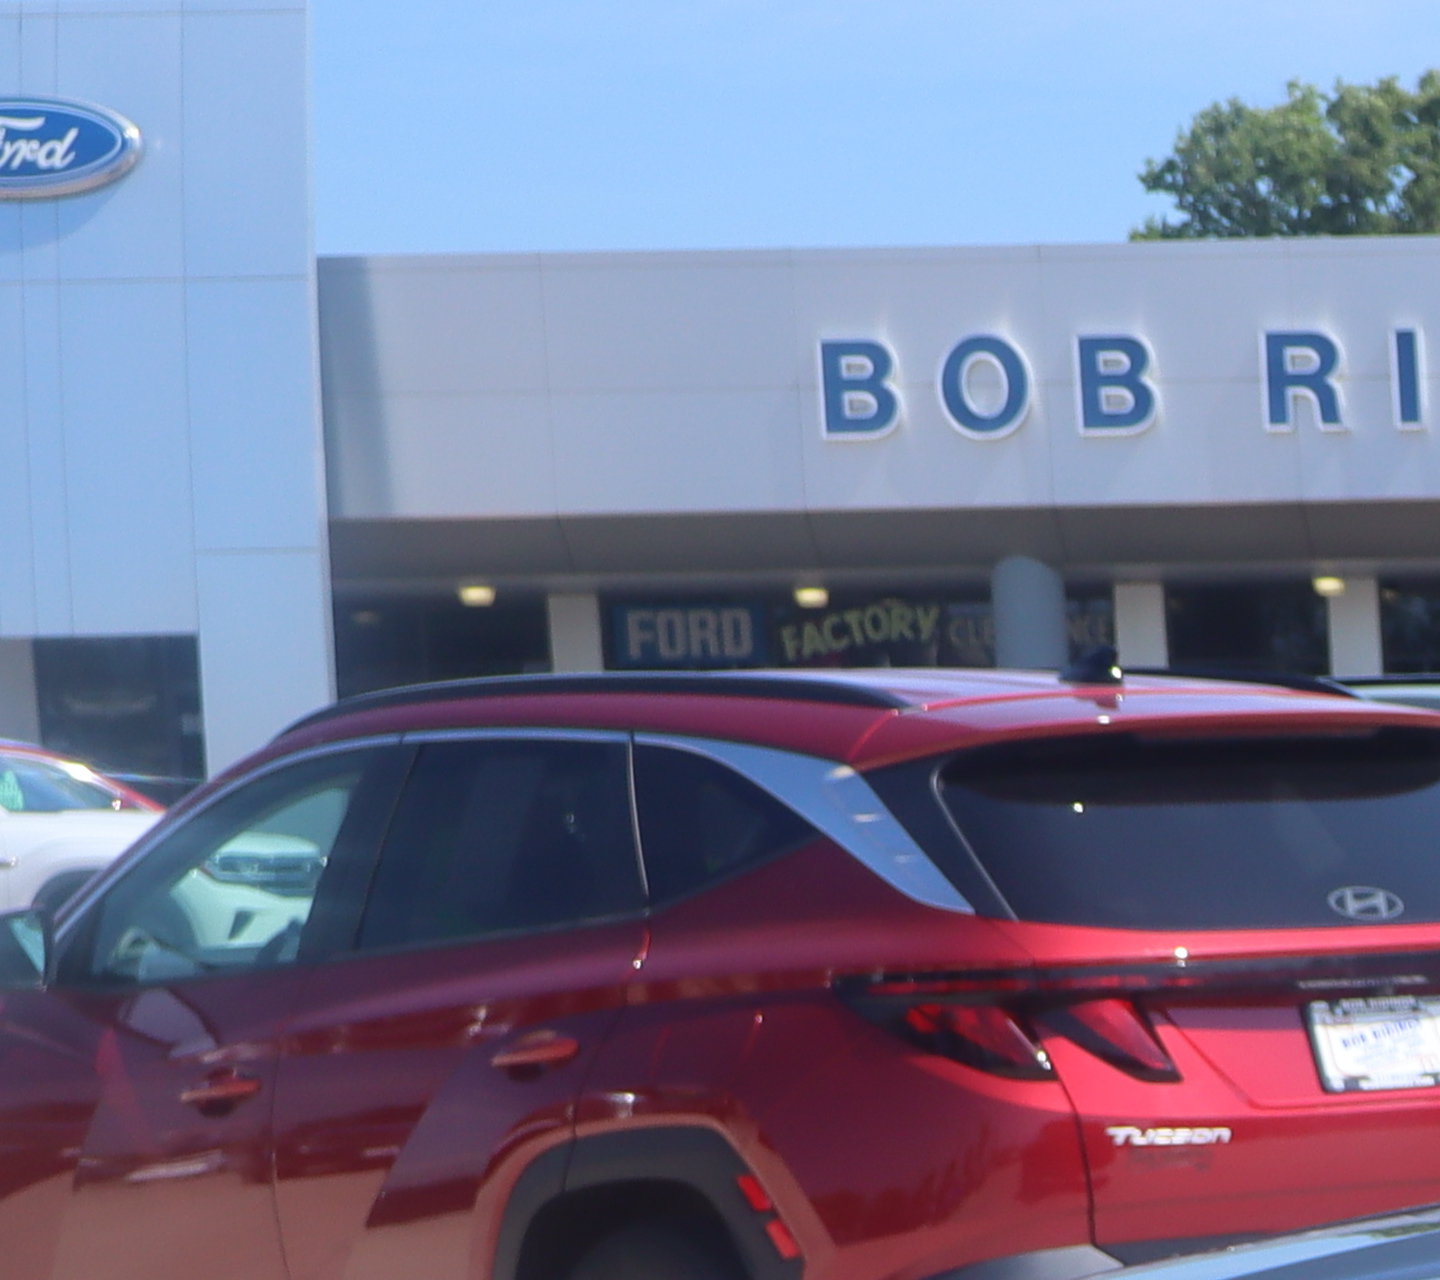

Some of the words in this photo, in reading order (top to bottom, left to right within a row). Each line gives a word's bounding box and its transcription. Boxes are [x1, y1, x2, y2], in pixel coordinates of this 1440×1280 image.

[0, 115, 79, 170] rd
[819, 333, 1158, 437] BOB
[626, 608, 753, 661] FORD
[781, 604, 941, 662] FACTORY
